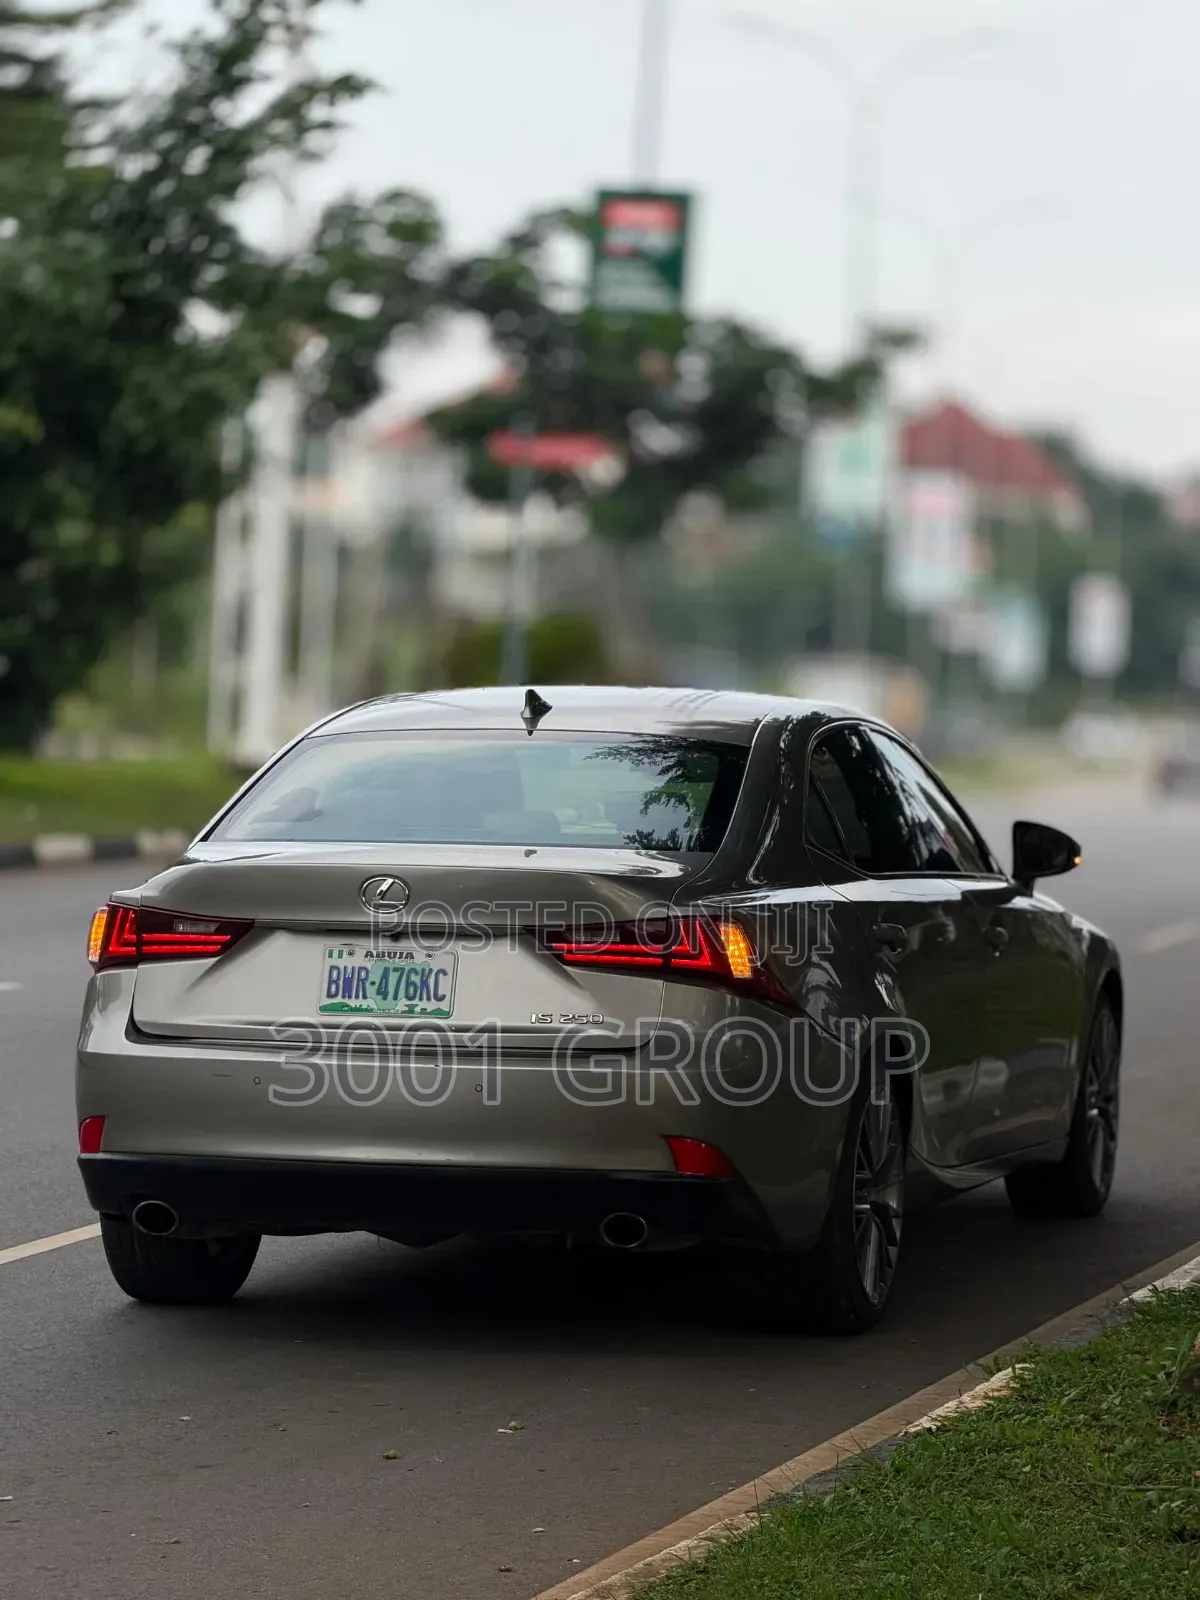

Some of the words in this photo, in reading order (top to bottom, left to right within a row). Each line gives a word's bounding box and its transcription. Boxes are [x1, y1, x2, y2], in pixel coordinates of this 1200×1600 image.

[364, 950, 415, 960] ABUJA
[326, 964, 449, 1003] BWR-476KC
[530, 1012, 553, 1024] IS
[559, 1012, 604, 1024] 250
